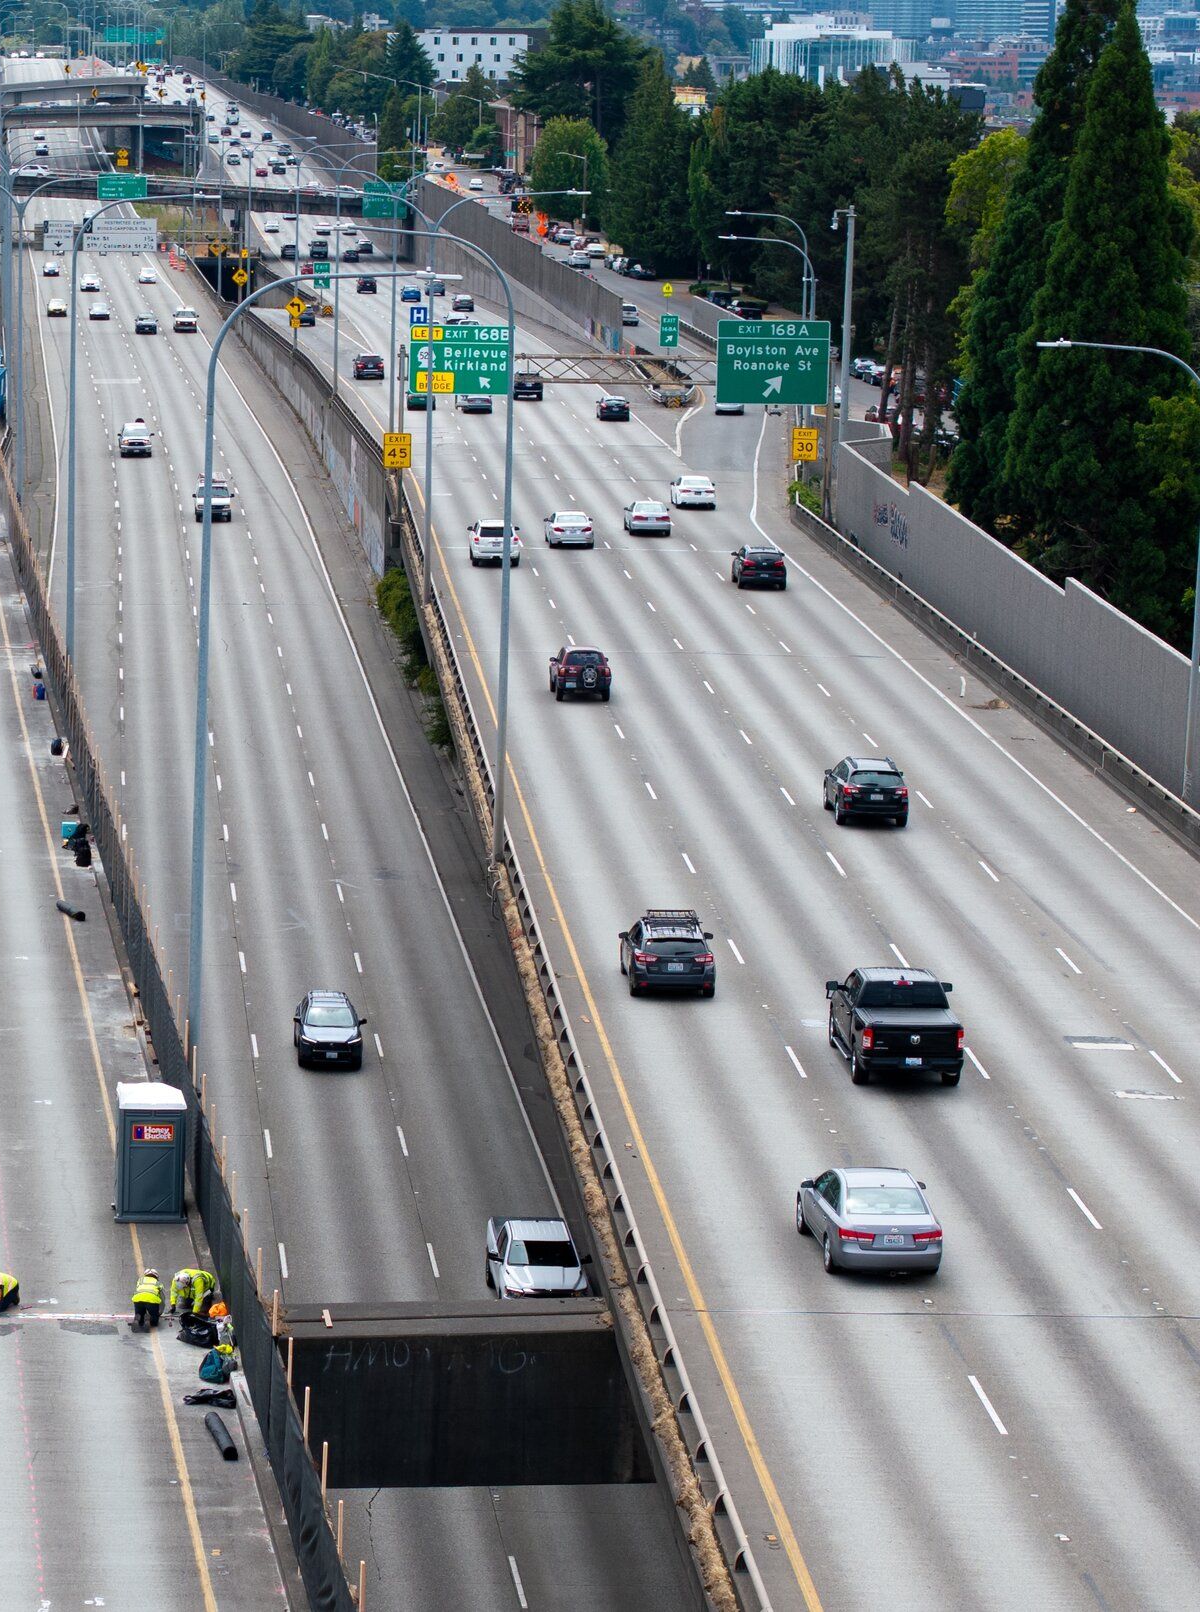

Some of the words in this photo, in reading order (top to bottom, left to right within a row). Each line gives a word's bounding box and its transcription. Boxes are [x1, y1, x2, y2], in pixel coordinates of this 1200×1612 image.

[414, 329, 441, 338] LET
[445, 329, 468, 339] EXIT
[474, 328, 510, 341] 168B
[738, 325, 763, 334] EXIT
[770, 323, 809, 336] 168A
[443, 347, 508, 358] Bellevue
[726, 344, 787, 358] Boylston
[794, 345, 819, 356] Ave
[443, 359, 507, 371] Kirkland
[733, 359, 790, 371] Roanoke
[798, 360, 812, 371] St
[423, 373, 447, 382] TOLL
[796, 441, 814, 452] 30
[388, 448, 407, 458] 45
[144, 1126, 169, 1134] Honey
